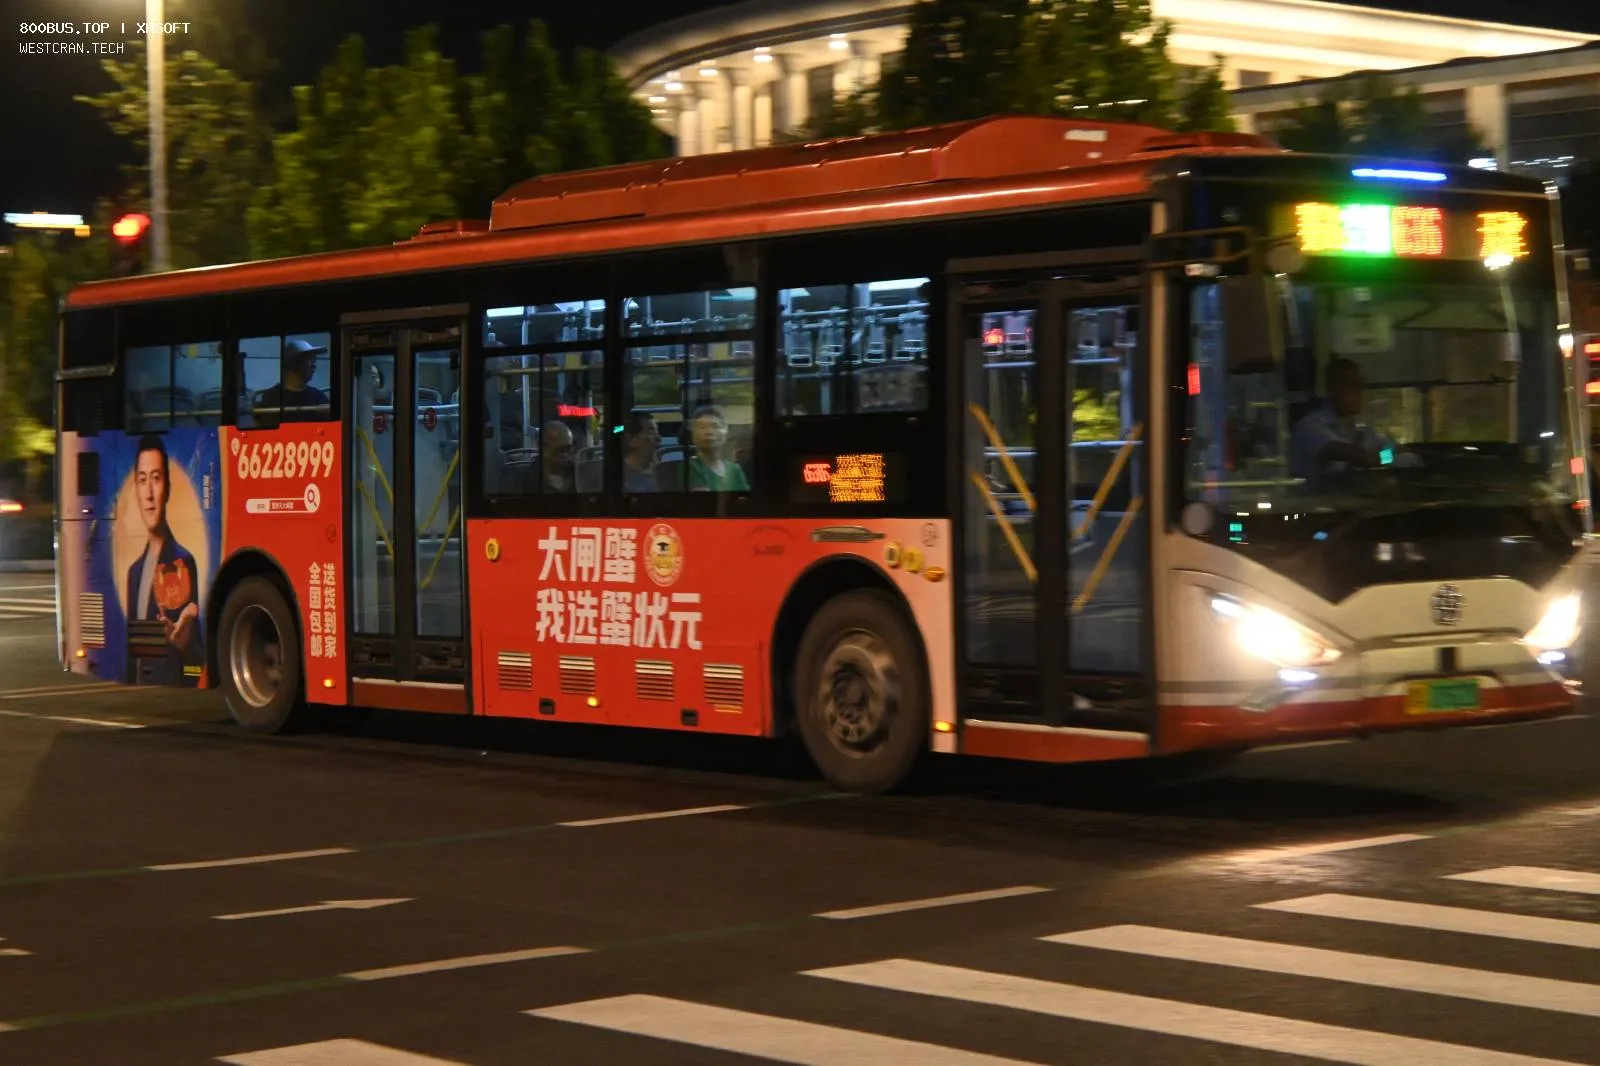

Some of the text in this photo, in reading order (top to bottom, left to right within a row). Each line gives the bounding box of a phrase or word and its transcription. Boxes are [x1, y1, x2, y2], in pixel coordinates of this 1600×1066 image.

[238, 440, 334, 479] 66228999
[538, 526, 638, 584] 大闸蟹
[308, 561, 323, 658] 全国包邮
[322, 562, 337, 659] 送货到家
[535, 587, 703, 650] 我选蟹状元
